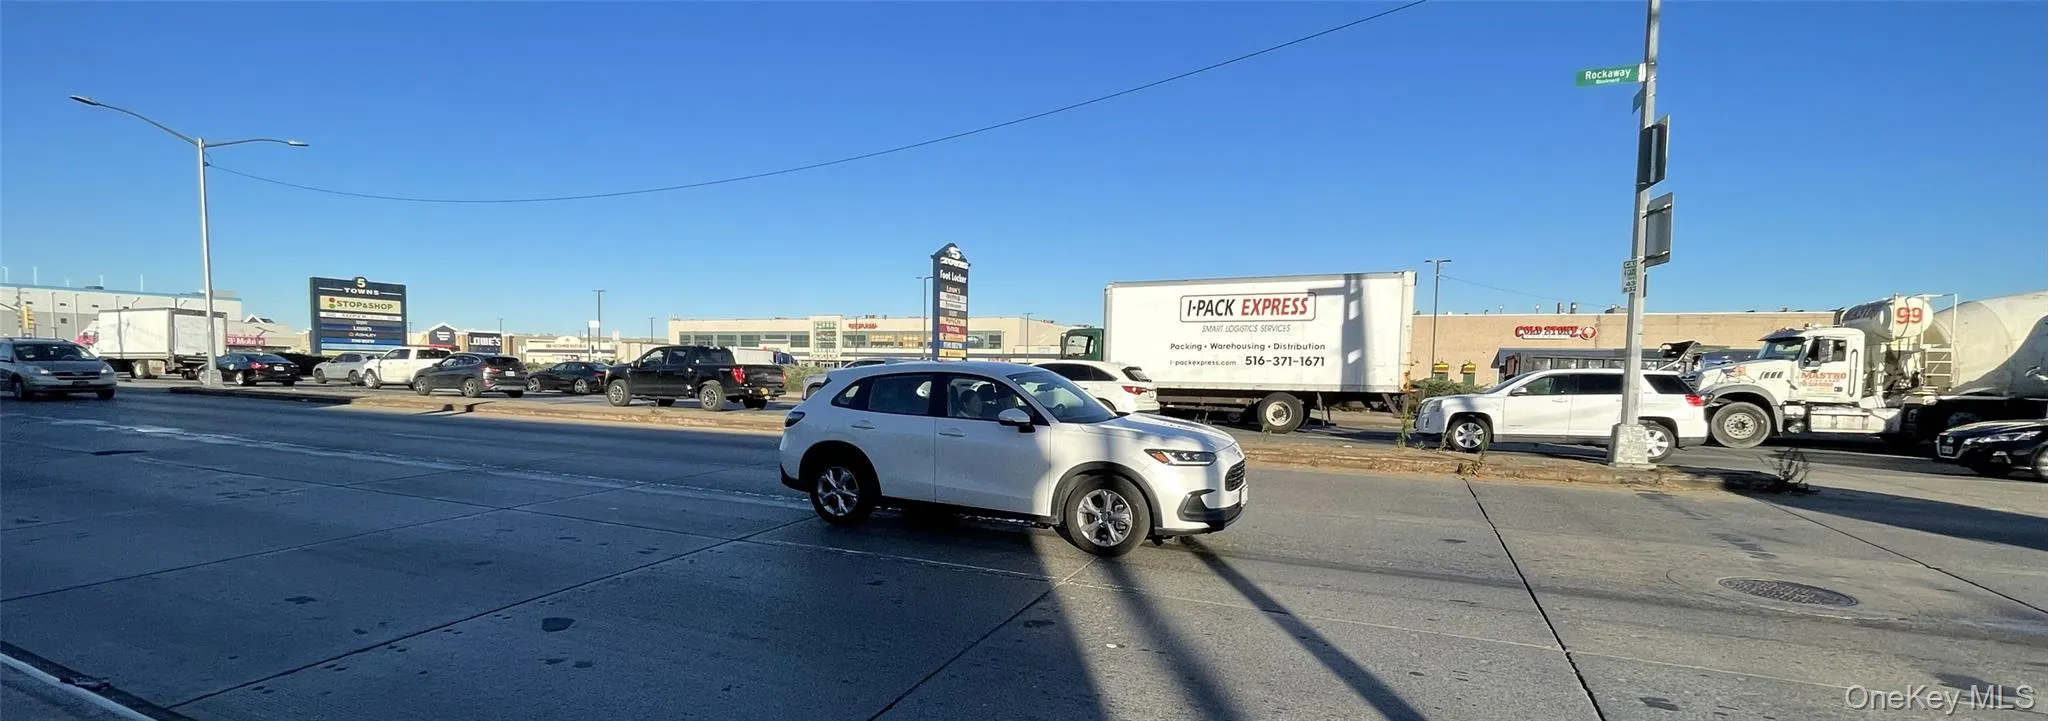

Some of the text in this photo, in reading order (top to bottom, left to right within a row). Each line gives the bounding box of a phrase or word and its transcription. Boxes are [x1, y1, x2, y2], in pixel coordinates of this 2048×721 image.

[1585, 68, 1631, 80] Rockaway
[940, 269, 967, 283] Foot Locker
[356, 278, 366, 288] 5
[343, 287, 379, 296] TOWNS
[1241, 297, 1309, 316] EXPRESS
[1896, 307, 1923, 324] 99
[1202, 324, 1291, 333] SMART LOGISTICS SERVICES
[1515, 325, 1579, 337] COLD STONE
[469, 335, 501, 346] LOWE'S
[1170, 342, 1326, 351] Packing Warehousing Distribution
[1245, 356, 1325, 366] 516-371-1671
[1800, 371, 1847, 380] MASTRO
